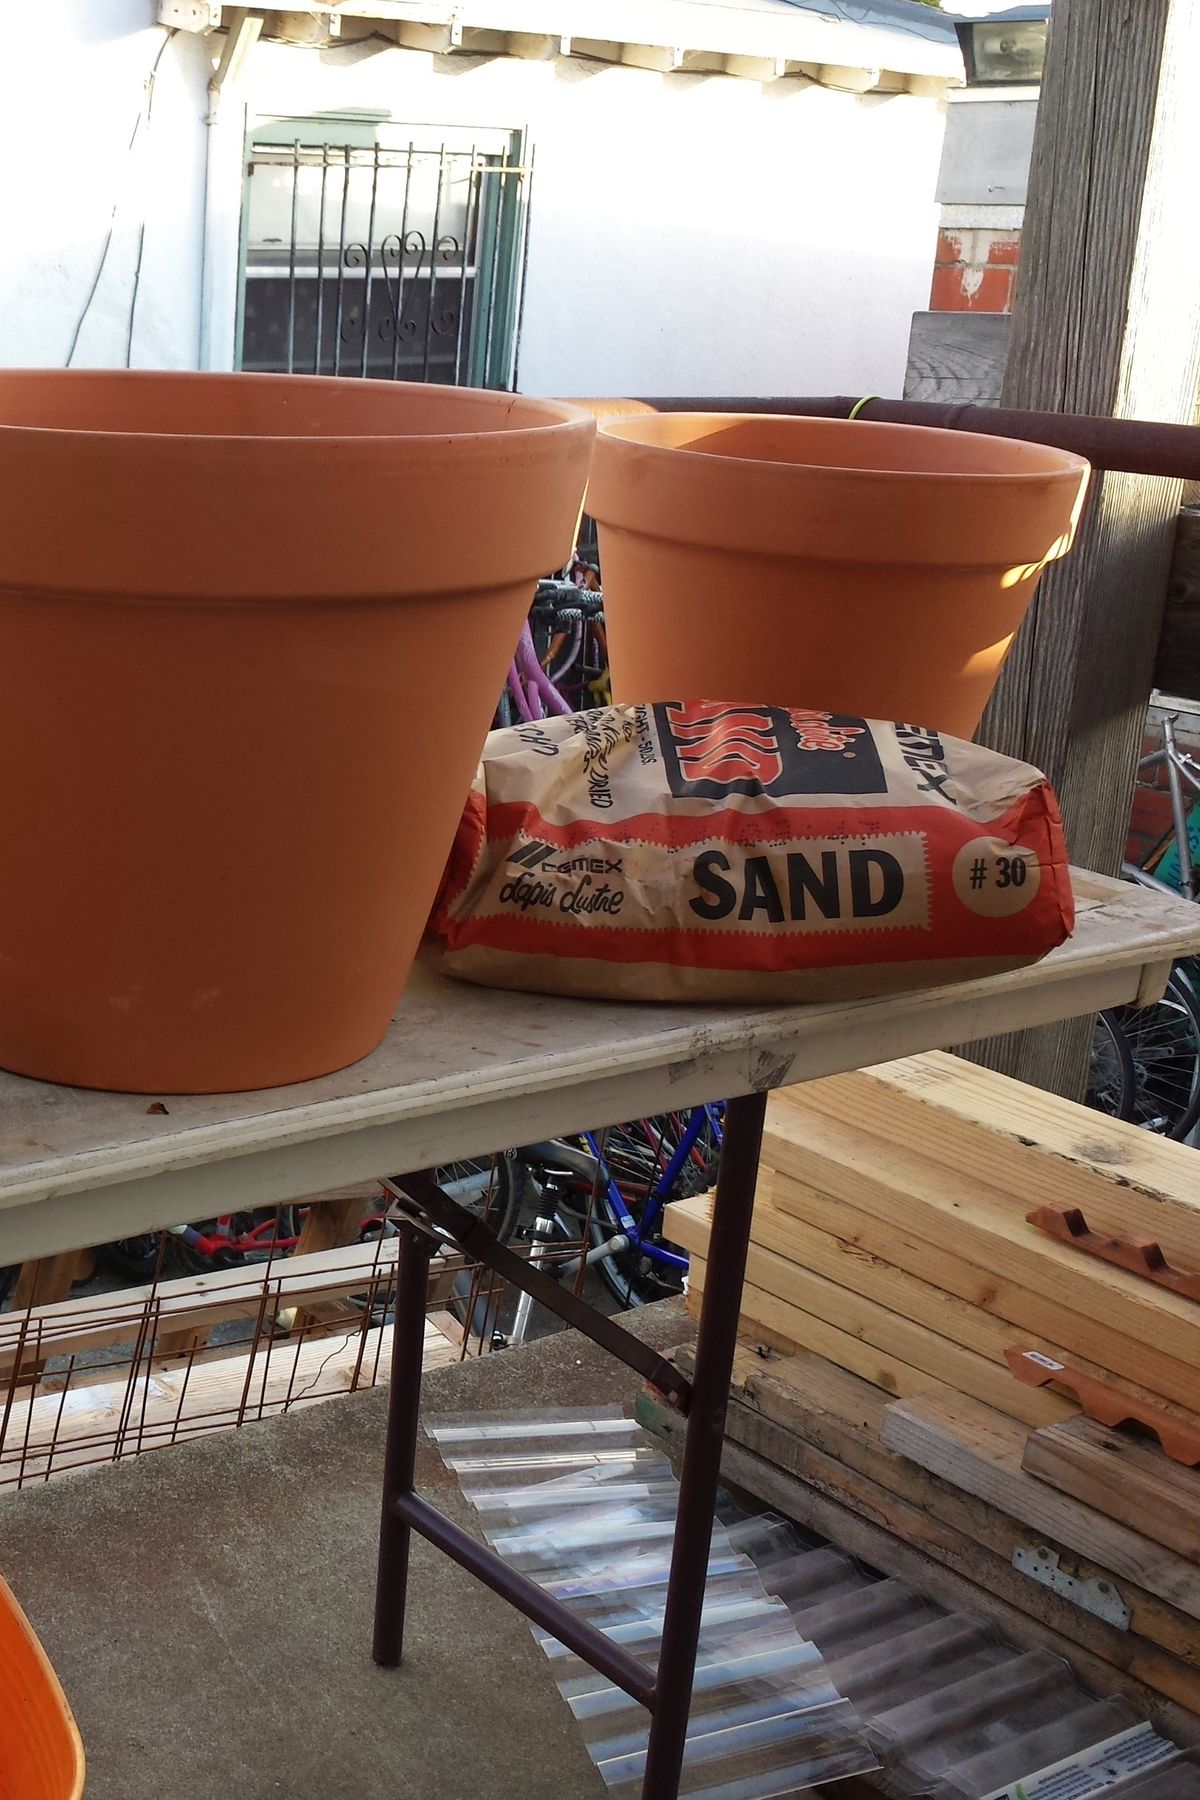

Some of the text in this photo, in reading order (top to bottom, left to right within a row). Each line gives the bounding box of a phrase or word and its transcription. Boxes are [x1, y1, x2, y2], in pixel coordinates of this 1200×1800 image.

[634, 704, 647, 734] IGHT
[665, 701, 784, 785] AND
[895, 721, 957, 805] EMEX
[588, 767, 614, 809] DRIED
[541, 855, 623, 874] CEMEX
[995, 856, 1027, 889] 30
[688, 849, 905, 924] SAND
